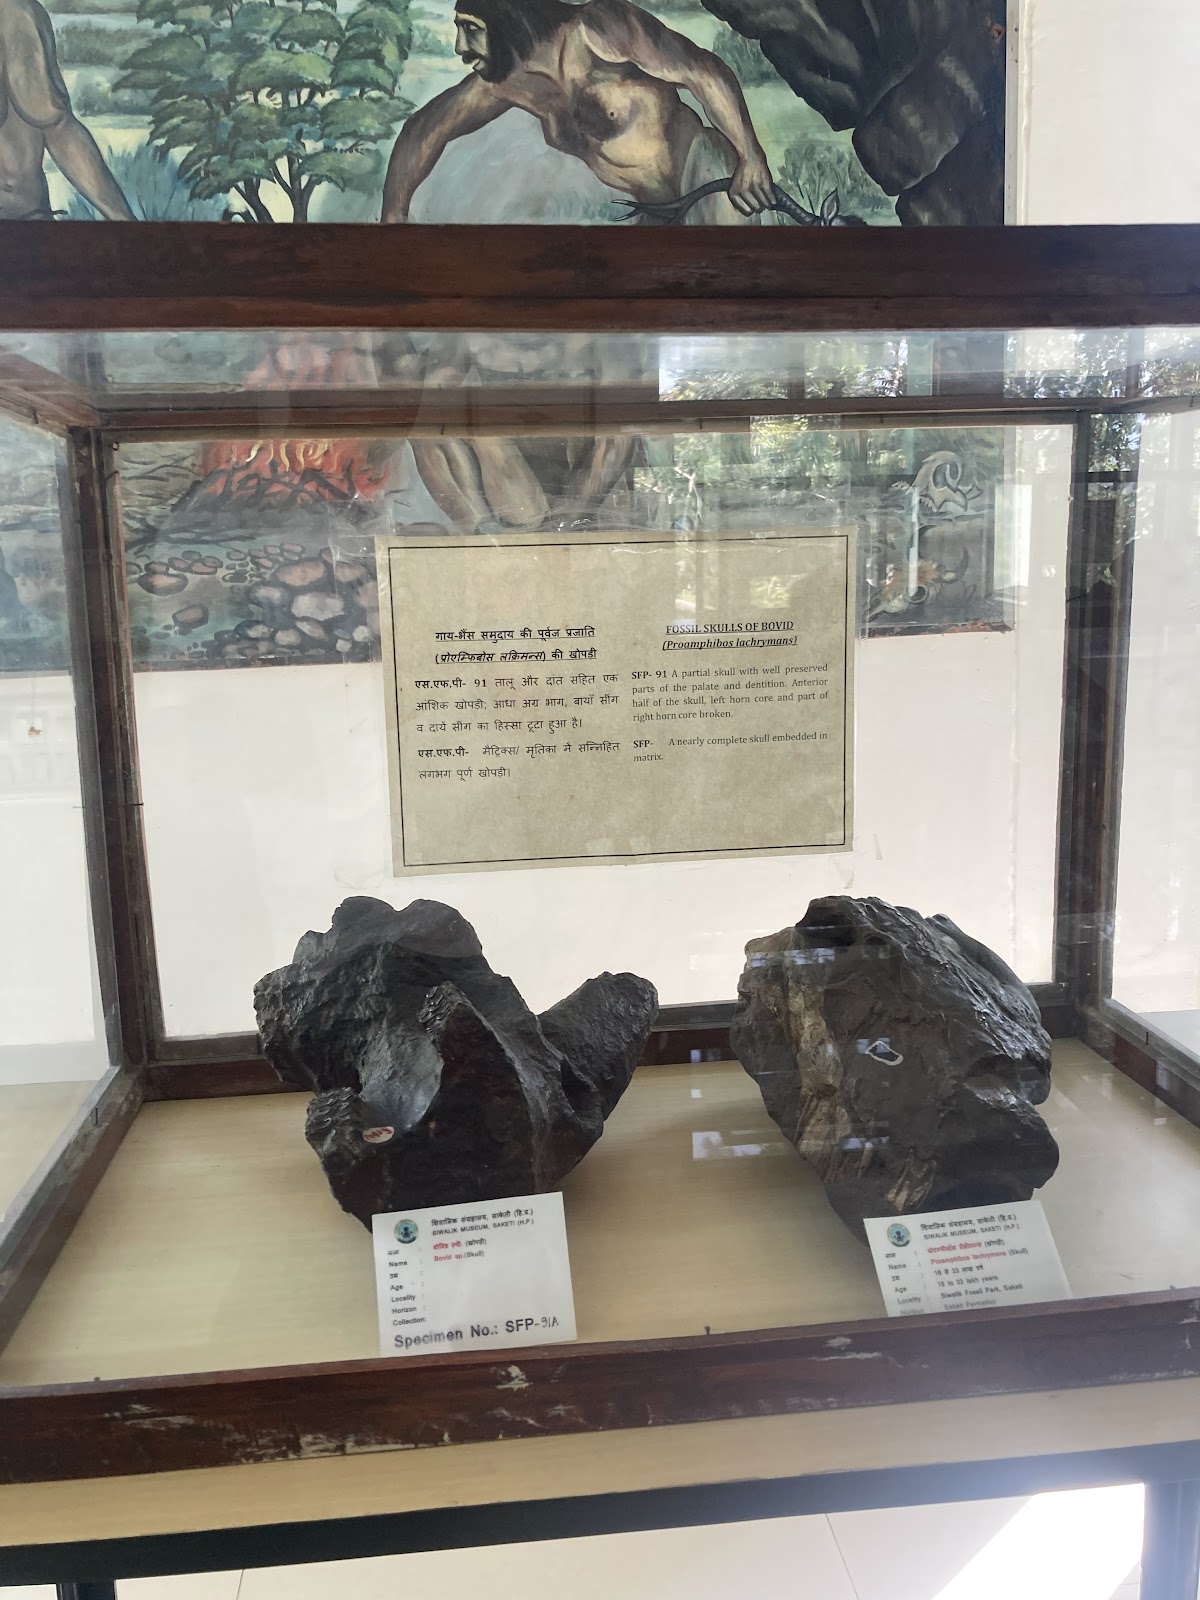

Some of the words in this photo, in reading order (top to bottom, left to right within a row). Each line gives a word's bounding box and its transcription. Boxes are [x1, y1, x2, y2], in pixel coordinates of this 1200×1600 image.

[435, 628, 475, 641] गाय-भैंस
[481, 630, 514, 643] समुदाय
[520, 628, 532, 638] की
[538, 627, 560, 641] पूर्वज
[566, 625, 595, 637] प्रजाति
[666, 624, 701, 634] FOSSIL
[704, 624, 743, 633] SKULLS
[745, 623, 759, 631] OF
[761, 621, 794, 630] BOVID
[662, 638, 733, 651] (Proamphibos
[736, 636, 797, 648] lachrymans)
[552, 649, 563, 658] की
[632, 671, 652, 679] SFP-
[682, 669, 710, 679] partial
[715, 668, 735, 676] skull
[739, 667, 758, 675] with
[762, 666, 780, 674] well
[785, 664, 828, 674] preserved
[415, 677, 466, 689] एस.एफ.पी-
[474, 679, 487, 687] 91
[495, 678, 516, 689] तालू
[522, 675, 538, 685] और
[546, 674, 563, 685] दांत
[571, 673, 595, 684] सहित
[603, 674, 618, 683] एक
[632, 685, 655, 695] parts
[660, 684, 669, 692] of
[673, 683, 686, 691] the
[692, 681, 719, 692] palate
[724, 681, 741, 689] and
[745, 679, 786, 688] dentition.
[792, 678, 828, 686] Anterior
[416, 699, 449, 710] आंशिक
[494, 699, 515, 708] आधा
[523, 699, 539, 708] अग्र
[632, 699, 648, 707] half
[653, 698, 662, 706] of
[666, 698, 679, 706] the
[683, 696, 706, 706] skull,
[711, 696, 725, 704] left
[729, 695, 750, 704] horn
[754, 694, 773, 702] core
[777, 693, 794, 701] and
[797, 692, 816, 702] part
[819, 691, 829, 699] of
[633, 713, 653, 723] right
[656, 712, 676, 720] horn
[678, 711, 697, 719] core
[699, 710, 733, 718] broken.
[417, 723, 423, 732] व
[477, 722, 488, 730] का
[494, 720, 521, 730] हिस्सा
[528, 720, 543, 732] टूटा
[549, 719, 566, 733] हुआ
[633, 739, 653, 748] SFP-
[669, 738, 675, 746] A
[677, 737, 704, 747] nearly
[707, 735, 748, 746] complete
[749, 734, 770, 743] skull
[772, 732, 817, 742] embedded
[819, 731, 827, 740] in
[418, 746, 469, 758] एस.एफ.पी-
[563, 742, 572, 752] में
[633, 753, 664, 762] matrix.
[419, 770, 451, 779] लगभग
[457, 767, 472, 781] पूर्ण
[432, 1227, 458, 1236] SIWALIK
[493, 1221, 515, 1229] SAKETI
[923, 1232, 948, 1240] SIWALIK
[980, 1226, 1002, 1234] SAKETI
[434, 1253, 452, 1262] Bovid
[982, 1275, 998, 1283] years
[391, 1295, 416, 1303] Locality
[392, 1306, 417, 1314] Horizon
[394, 1329, 463, 1349] Specimen
[471, 1325, 498, 1338] No.:
